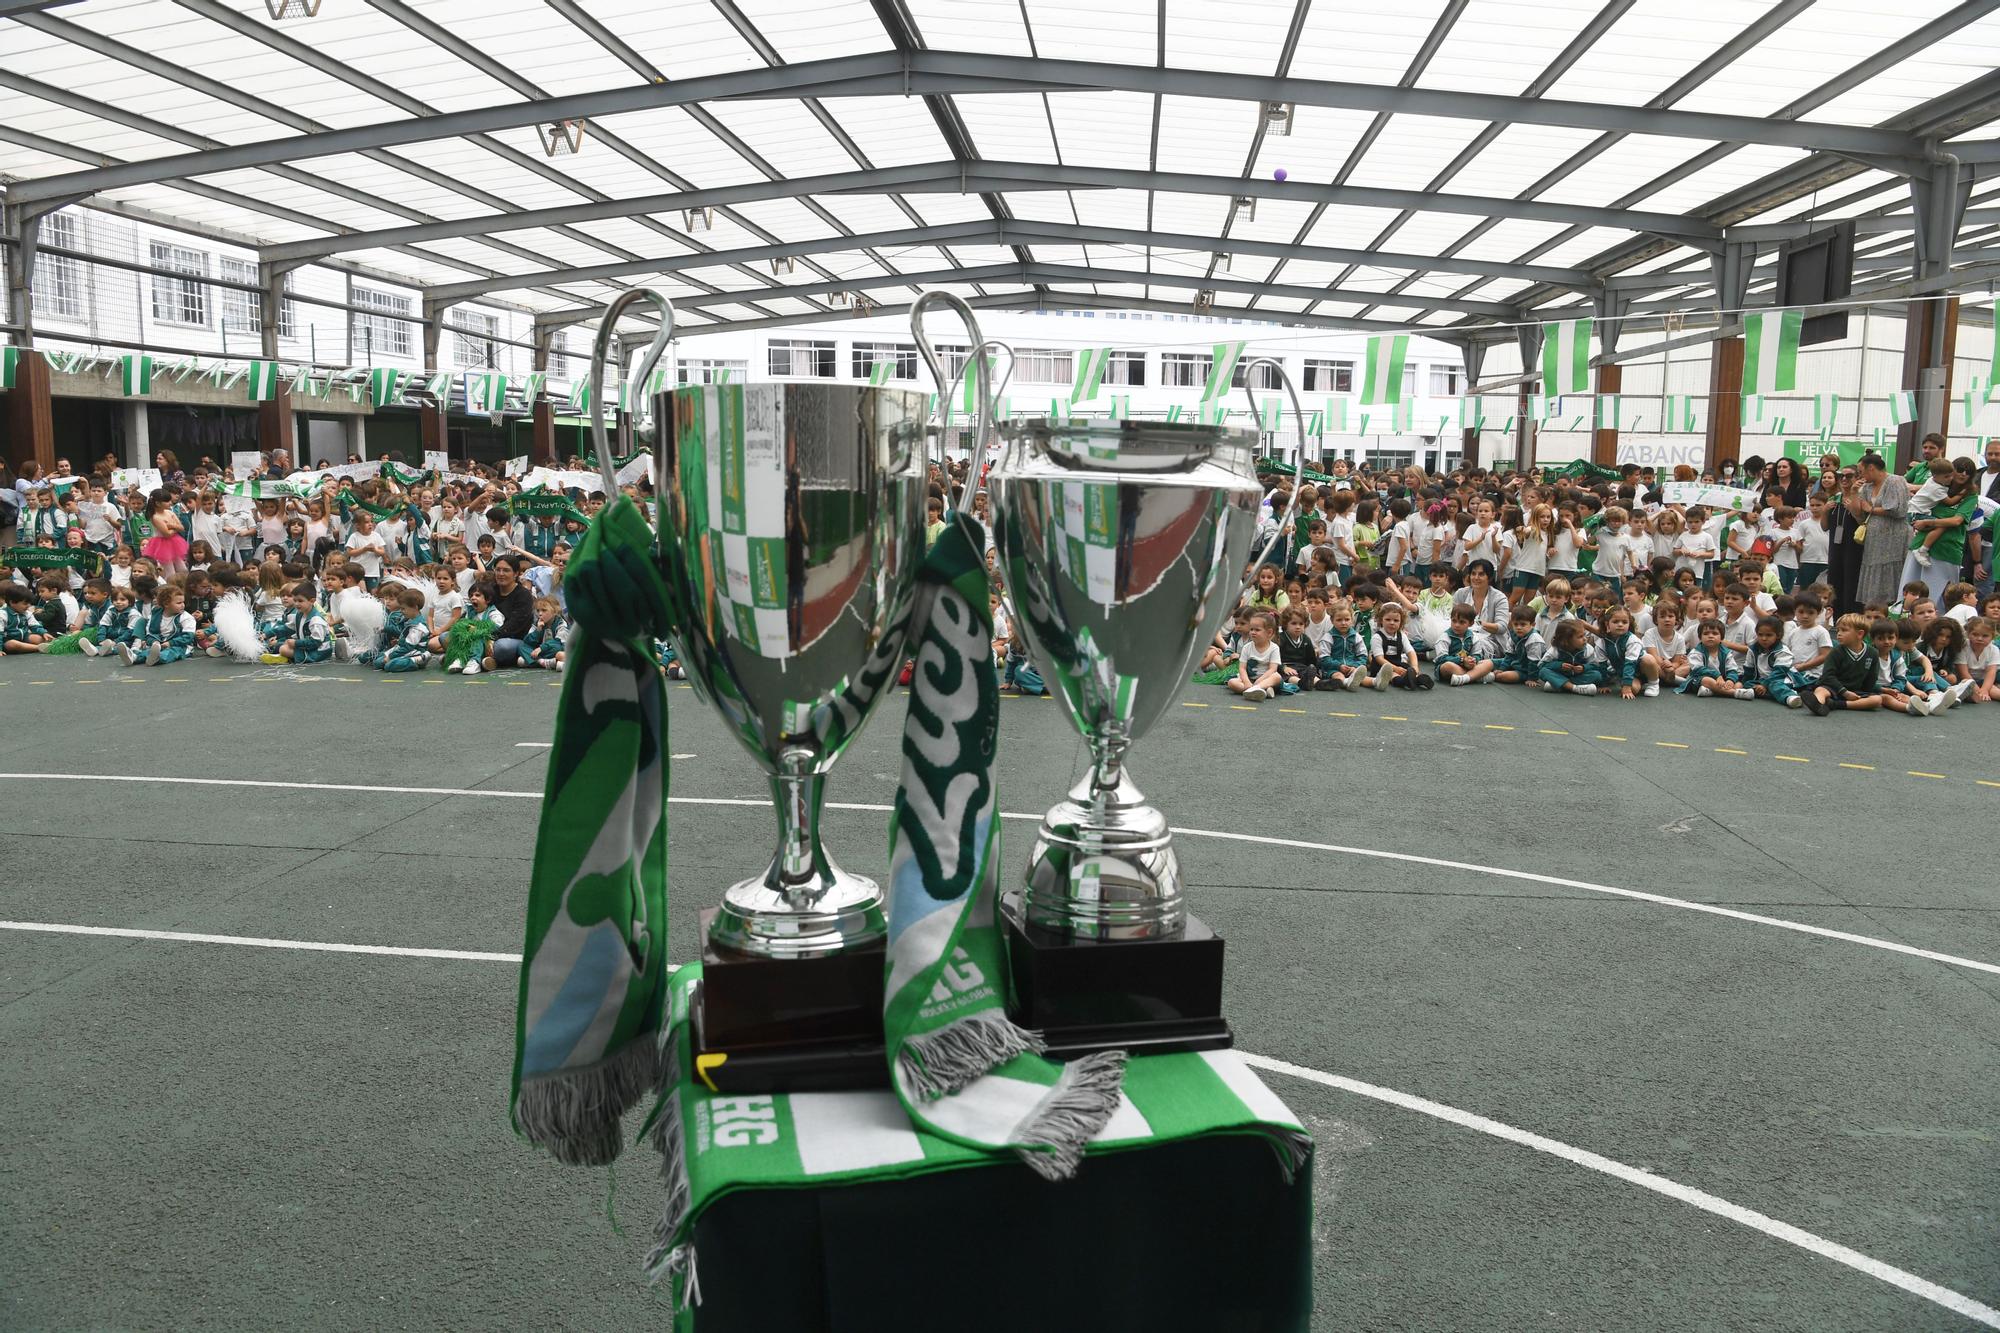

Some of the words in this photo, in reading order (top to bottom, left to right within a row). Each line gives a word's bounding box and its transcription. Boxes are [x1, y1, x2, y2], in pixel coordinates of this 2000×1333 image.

[1672, 489, 1682, 501] 5
[1695, 490, 1709, 502] 7
[1731, 495, 1743, 509] 8
[711, 1094, 779, 1149] HG
